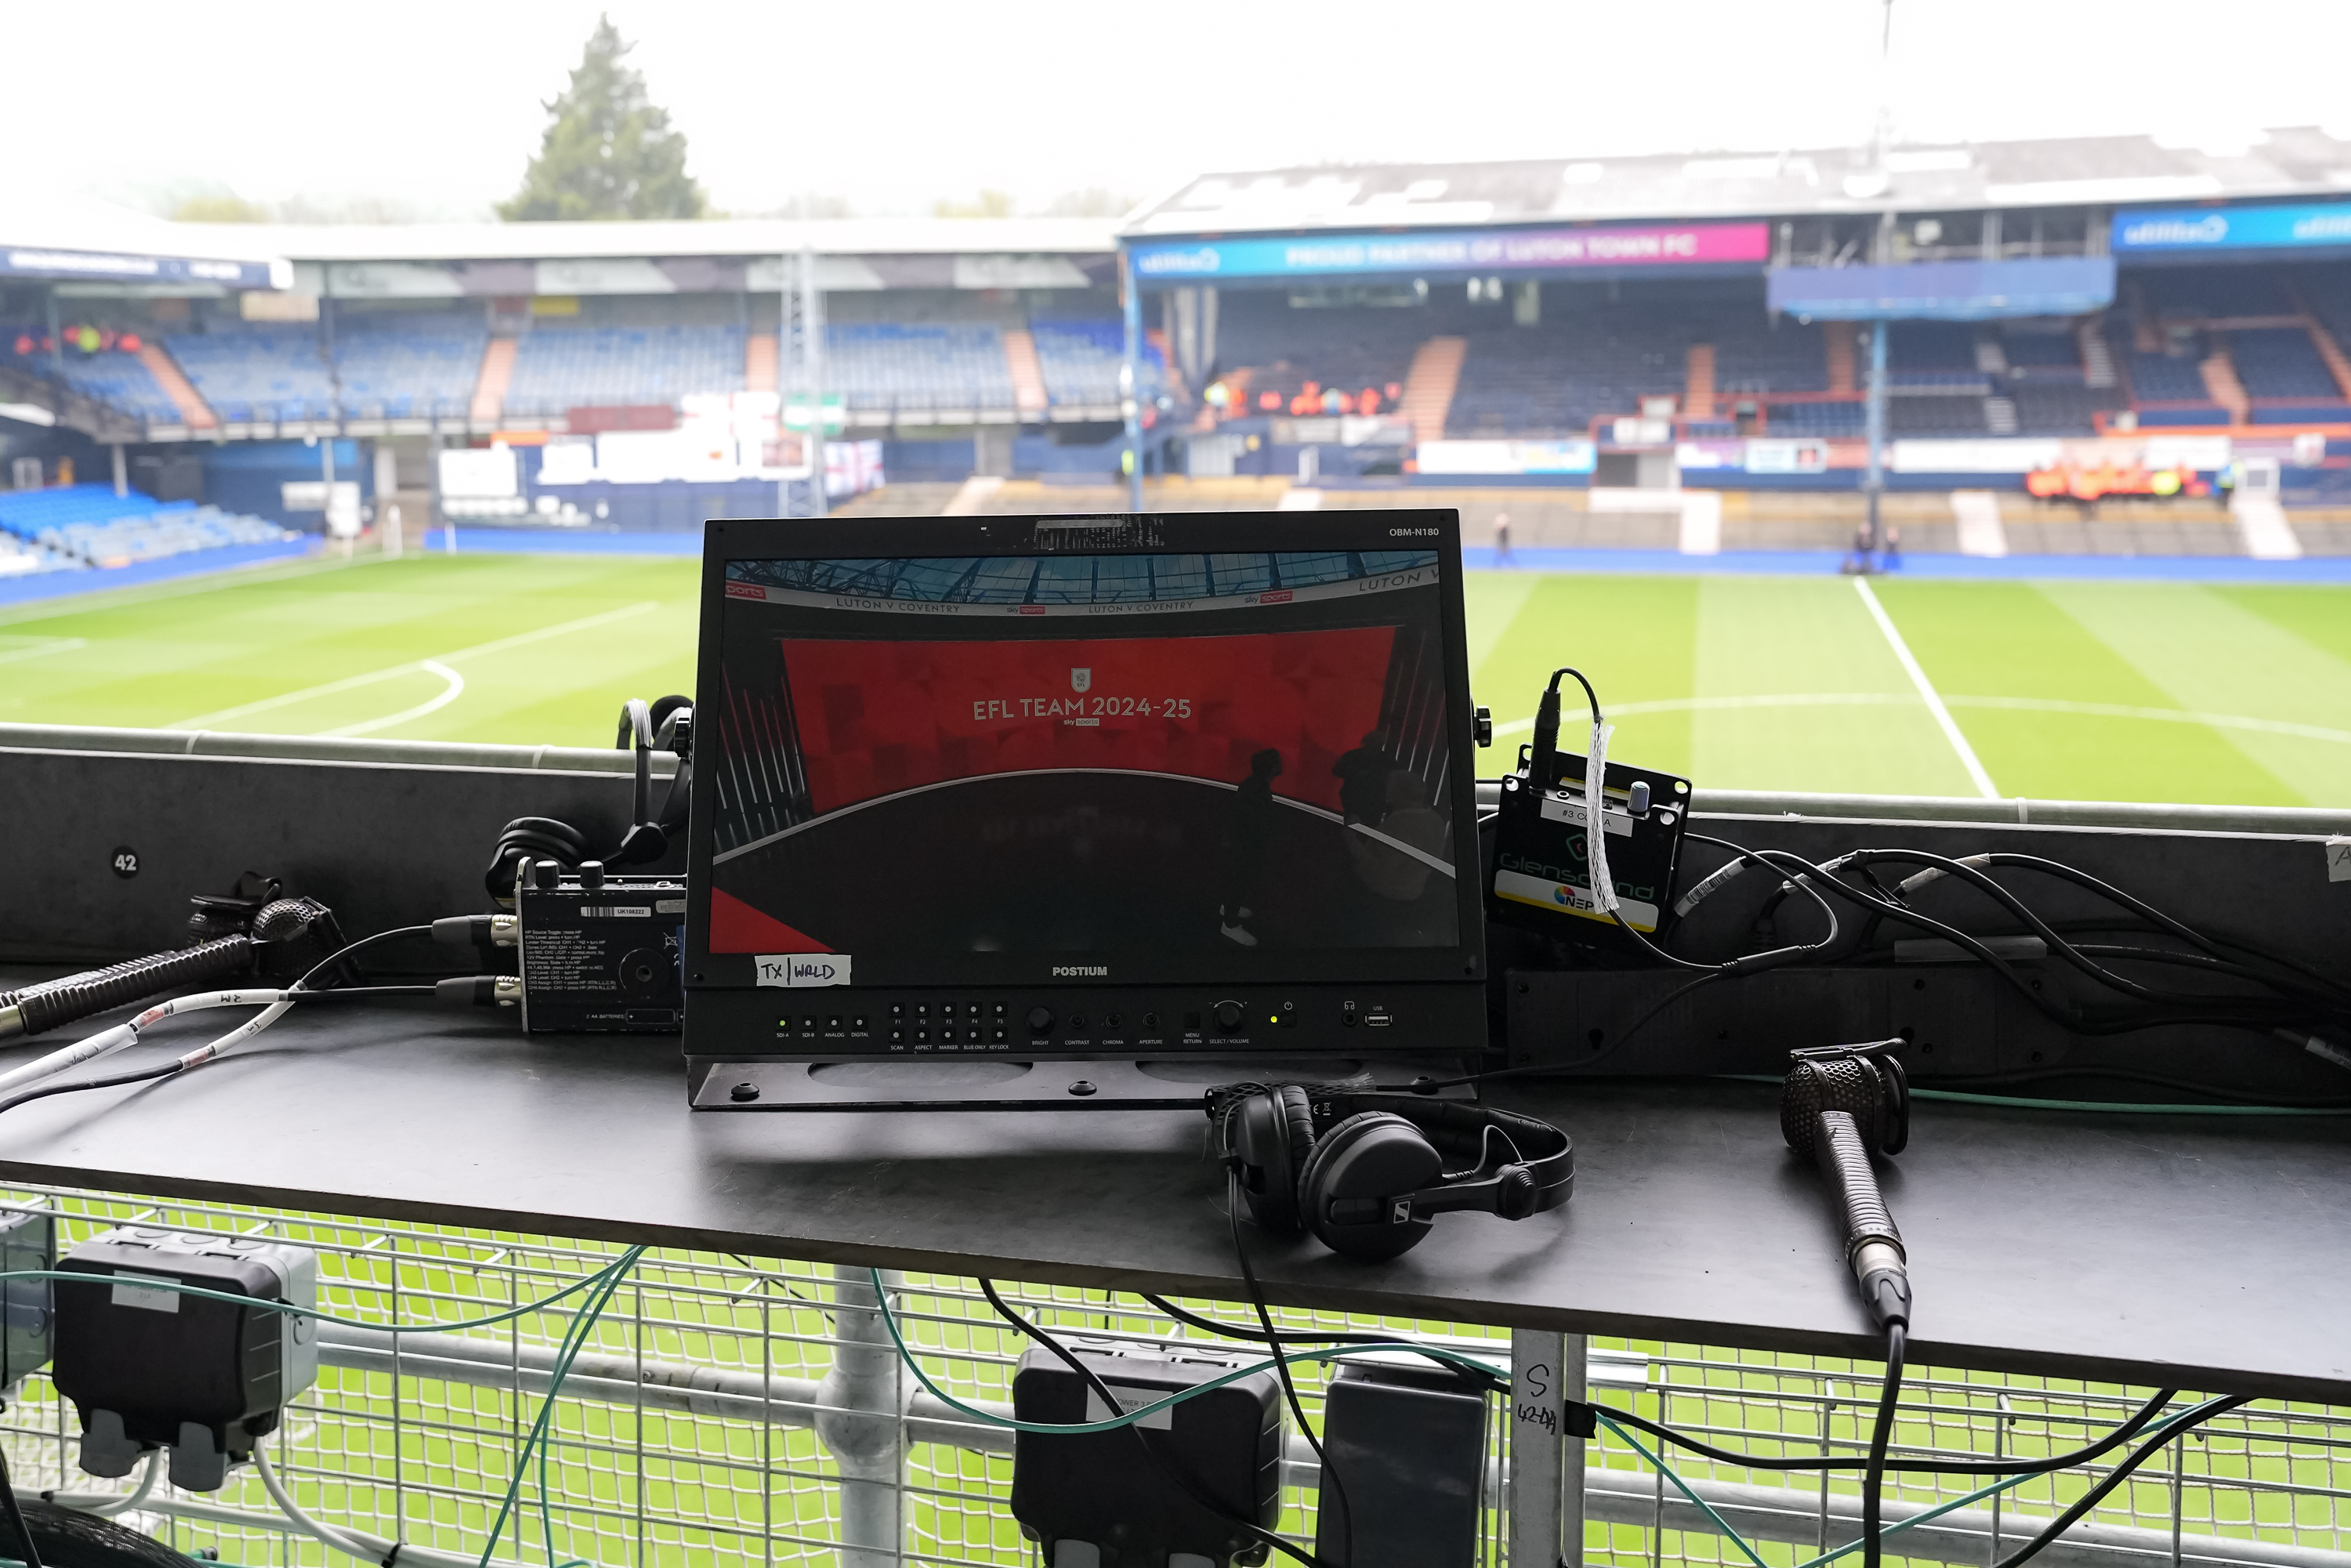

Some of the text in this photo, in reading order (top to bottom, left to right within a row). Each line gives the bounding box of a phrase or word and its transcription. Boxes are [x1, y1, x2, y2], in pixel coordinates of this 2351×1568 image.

[1506, 238, 1584, 262] LUTON
[1587, 236, 1659, 259] TOWN
[1389, 527, 1440, 537] OBM-N180
[1358, 571, 1422, 592] LUTON
[726, 585, 763, 596] ports
[1244, 592, 1291, 604] sky sports
[835, 598, 882, 609] LUTON
[898, 603, 960, 613] COVENTRY
[1089, 605, 1123, 614] LUTON
[1136, 602, 1194, 612] COVENTRY
[973, 697, 1191, 720] EFL TEAM 2024-25
[1562, 809, 1574, 818] #3
[114, 854, 137, 871] 42
[1500, 853, 1654, 900] Glensond
[1052, 966, 1107, 976] POSTIUM
[1526, 1364, 1549, 1397] S
